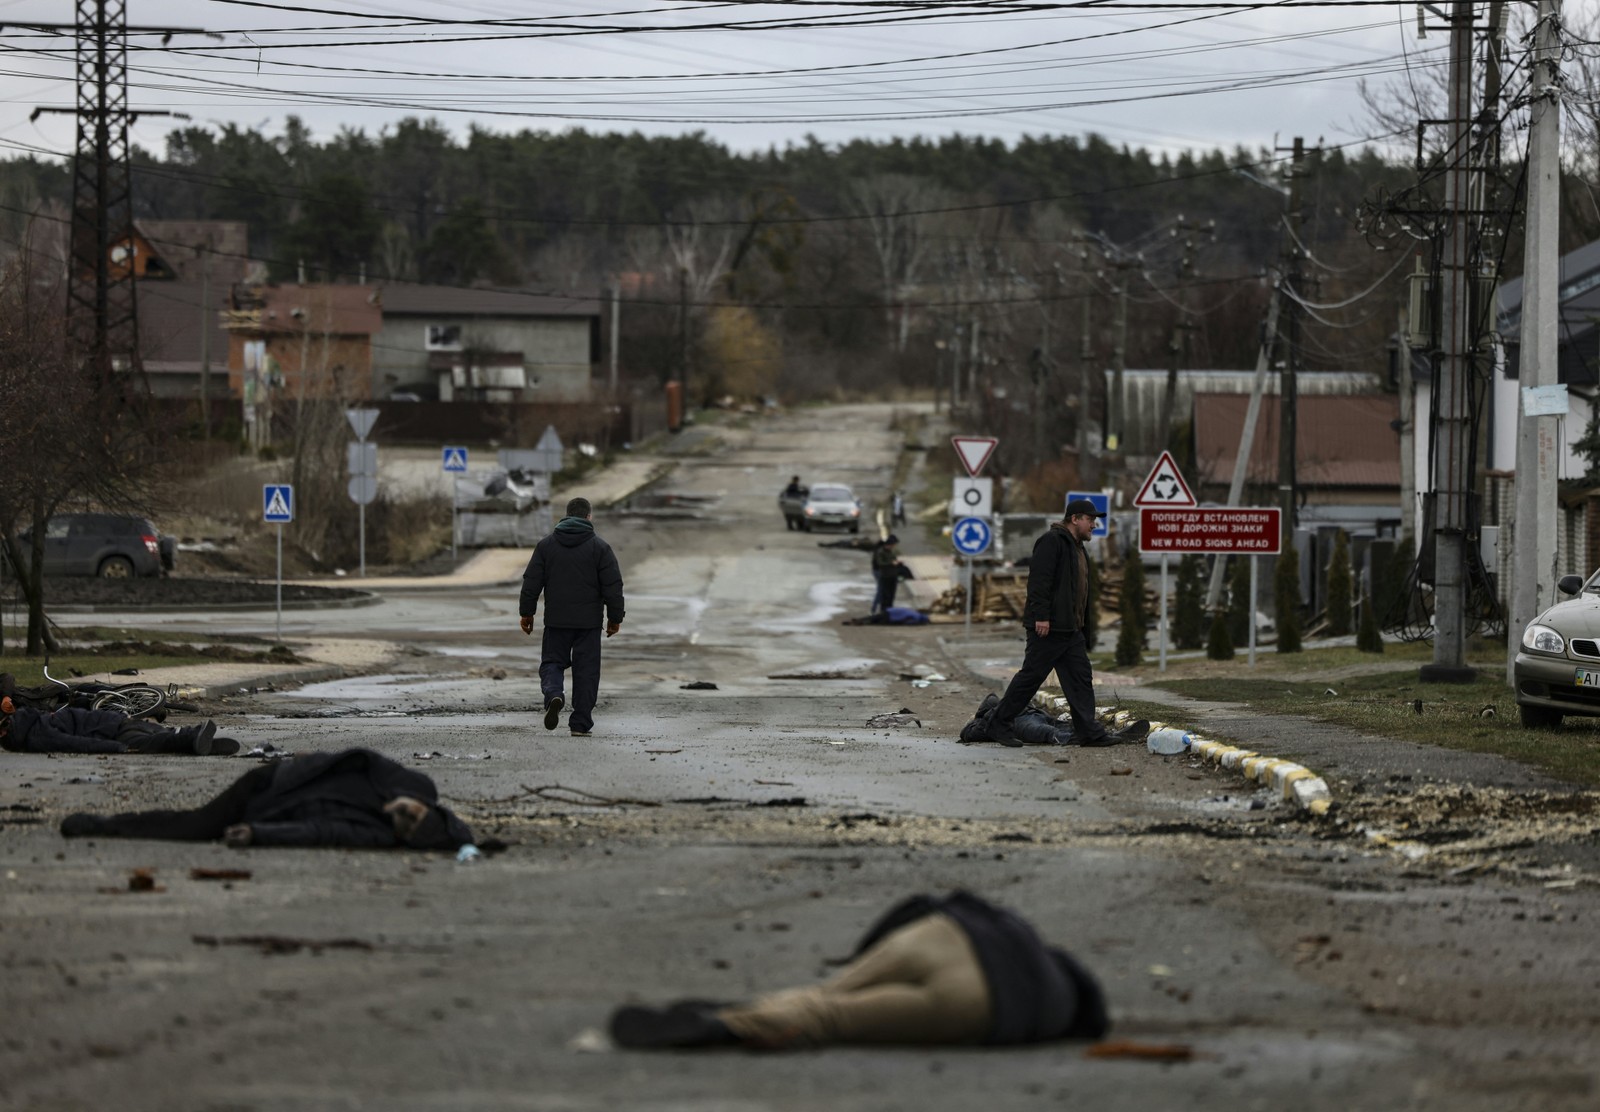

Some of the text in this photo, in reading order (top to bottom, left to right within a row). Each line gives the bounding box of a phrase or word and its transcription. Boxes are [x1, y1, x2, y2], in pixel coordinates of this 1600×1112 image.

[1151, 513, 1269, 522] ПОПЕРЕДУ ВСТАНОВЛЕНІ
[1157, 524, 1263, 533] НОВІ ДОРОЖНІ ЗНАКИ
[1151, 539, 1269, 548] NEW ROAD SIGNS AHEAD
